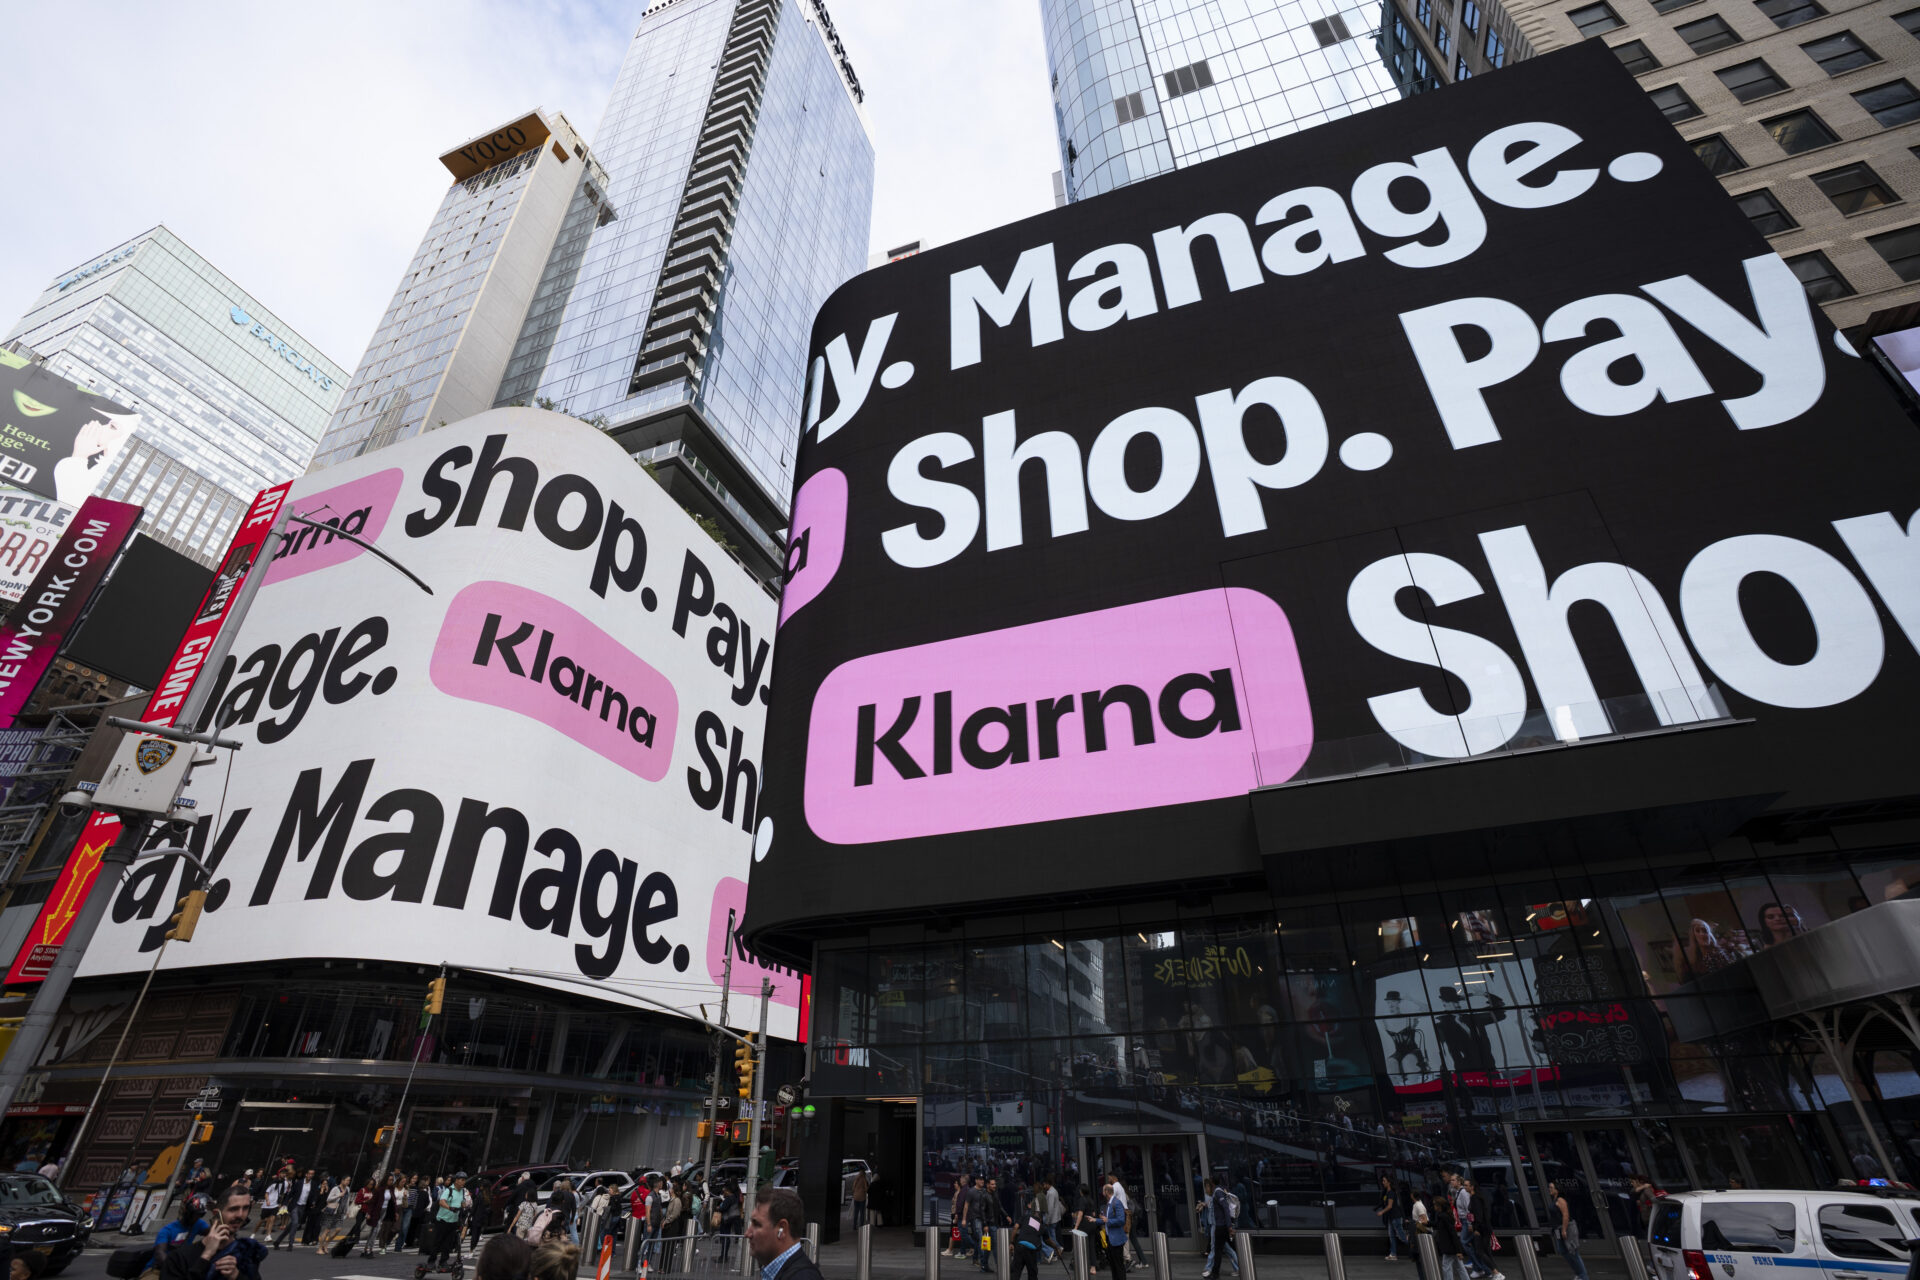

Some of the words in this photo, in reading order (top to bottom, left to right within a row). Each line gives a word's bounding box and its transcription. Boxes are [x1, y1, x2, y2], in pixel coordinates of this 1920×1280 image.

[950, 121, 1664, 371] Manage.
[250, 322, 333, 391] BARCLAYS
[3, 423, 51, 452] Heart.
[881, 376, 1393, 568] Shop.
[0, 494, 72, 527] TTLE
[404, 433, 658, 613] Shop.
[671, 547, 769, 707] Pay.
[152, 635, 212, 713] COME
[472, 612, 658, 749] Klarna
[853, 667, 1244, 788] Klarna
[176, 798, 195, 806] NYPD
[247, 758, 690, 981] Manage.
[1715, 1254, 1733, 1264] 5537
[1752, 1255, 1774, 1266] PBMS
